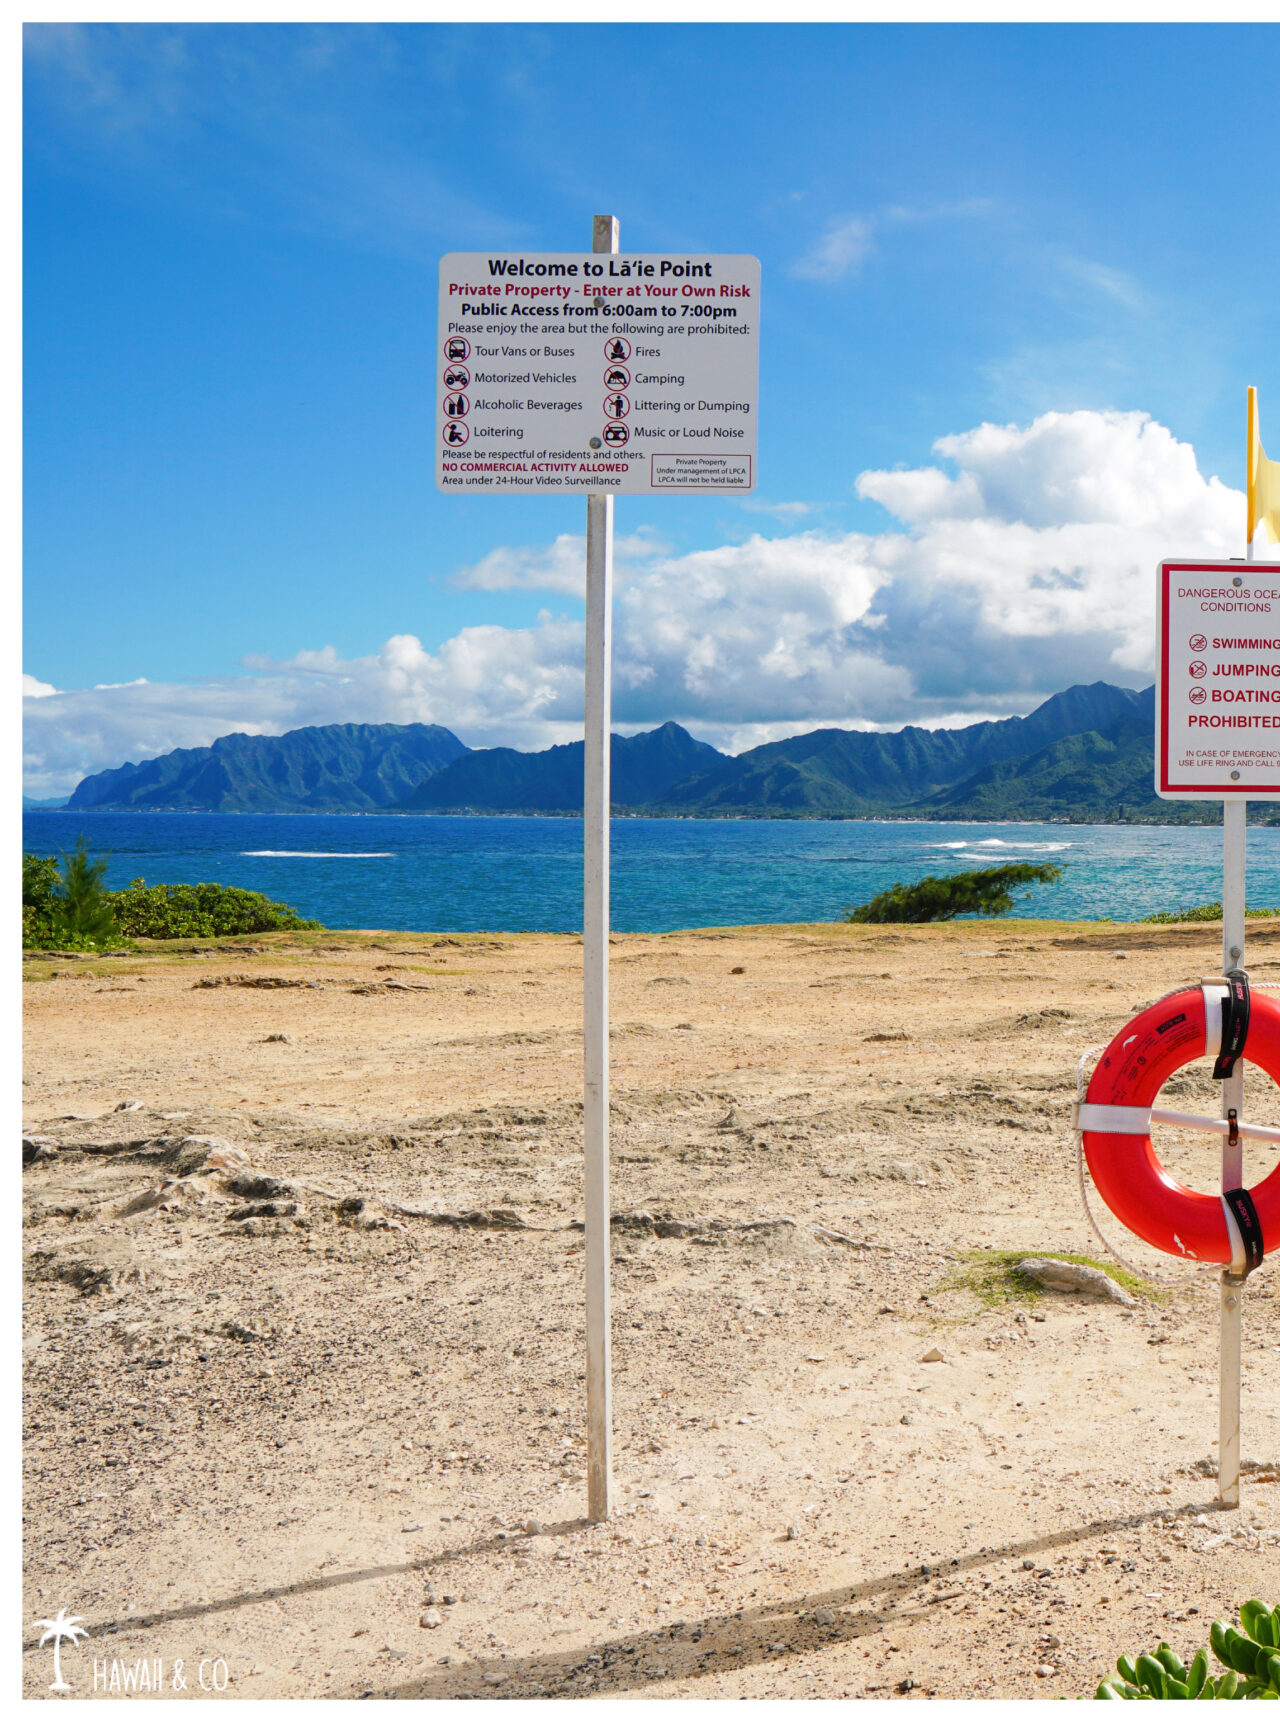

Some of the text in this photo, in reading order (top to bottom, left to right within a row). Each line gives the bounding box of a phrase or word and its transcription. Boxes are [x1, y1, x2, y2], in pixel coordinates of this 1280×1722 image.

[488, 259, 578, 276] Welcome
[583, 262, 604, 277] to
[660, 260, 712, 277] Point
[449, 283, 501, 296] Private
[505, 283, 571, 299] Property
[583, 284, 623, 297] Enter
[626, 285, 641, 296] at
[644, 284, 678, 297] Your
[681, 284, 715, 297] Own
[720, 284, 751, 297] Risk
[462, 303, 737, 320] Public Access from 6:00am to 7:00pm
[448, 322, 750, 336] Please enjoy the area but the following are prohibited:
[475, 346, 575, 357] Tour Vans or Buses
[636, 346, 661, 357] Fires
[475, 373, 577, 383] Motorized Vehicles
[635, 373, 685, 386] Camping
[474, 399, 583, 412] Alcoholic Beverages
[635, 400, 750, 414] Littering or Dumping
[474, 426, 524, 440] Loitering
[634, 427, 744, 438] Music or Loud Noise
[442, 448, 645, 460] Please be respectful of residents and others.
[442, 463, 629, 472] NO COMMERCIAL ACTIVITY ALLOWED
[699, 458, 727, 467] Property
[442, 475, 621, 486] Area under 24-Hour Video Surveillance
[1178, 588, 1251, 599] DANGEROUS
[1200, 602, 1271, 613] CONDITIONS
[1196, 750, 1217, 758] CASE
[1178, 759, 1195, 767] USE
[1197, 759, 1213, 767] LIFE
